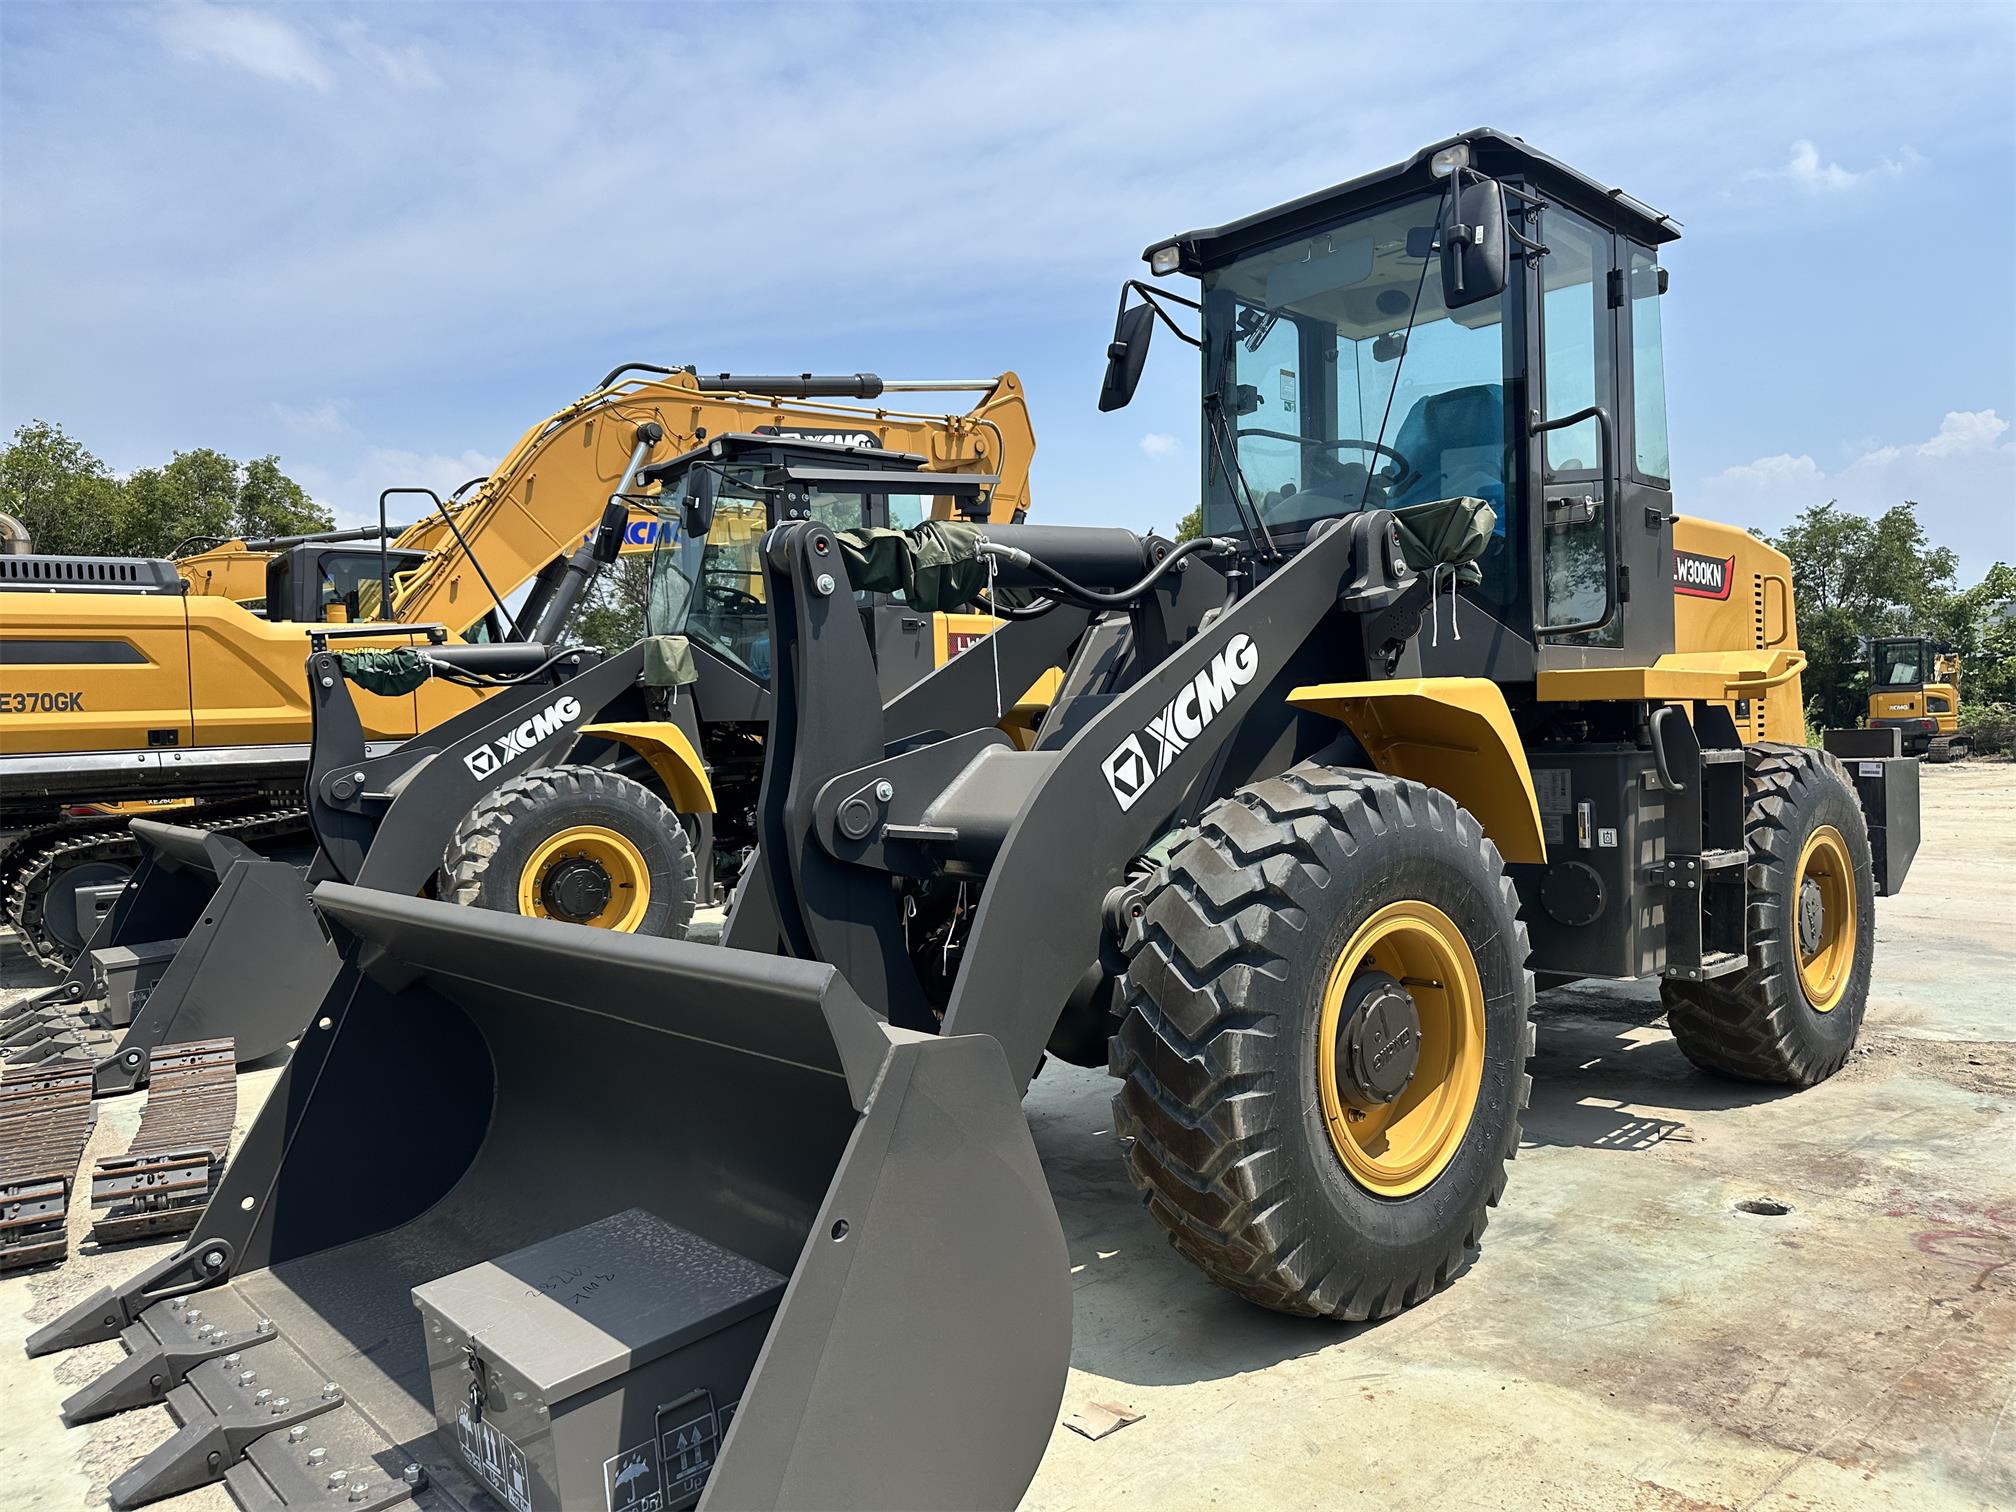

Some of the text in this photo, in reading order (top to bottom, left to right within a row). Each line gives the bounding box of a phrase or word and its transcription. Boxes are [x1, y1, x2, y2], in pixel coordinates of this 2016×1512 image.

[494, 696, 581, 766] XCMG
[1144, 633, 1259, 778] XCMG
[684, 1477, 701, 1492] Up
